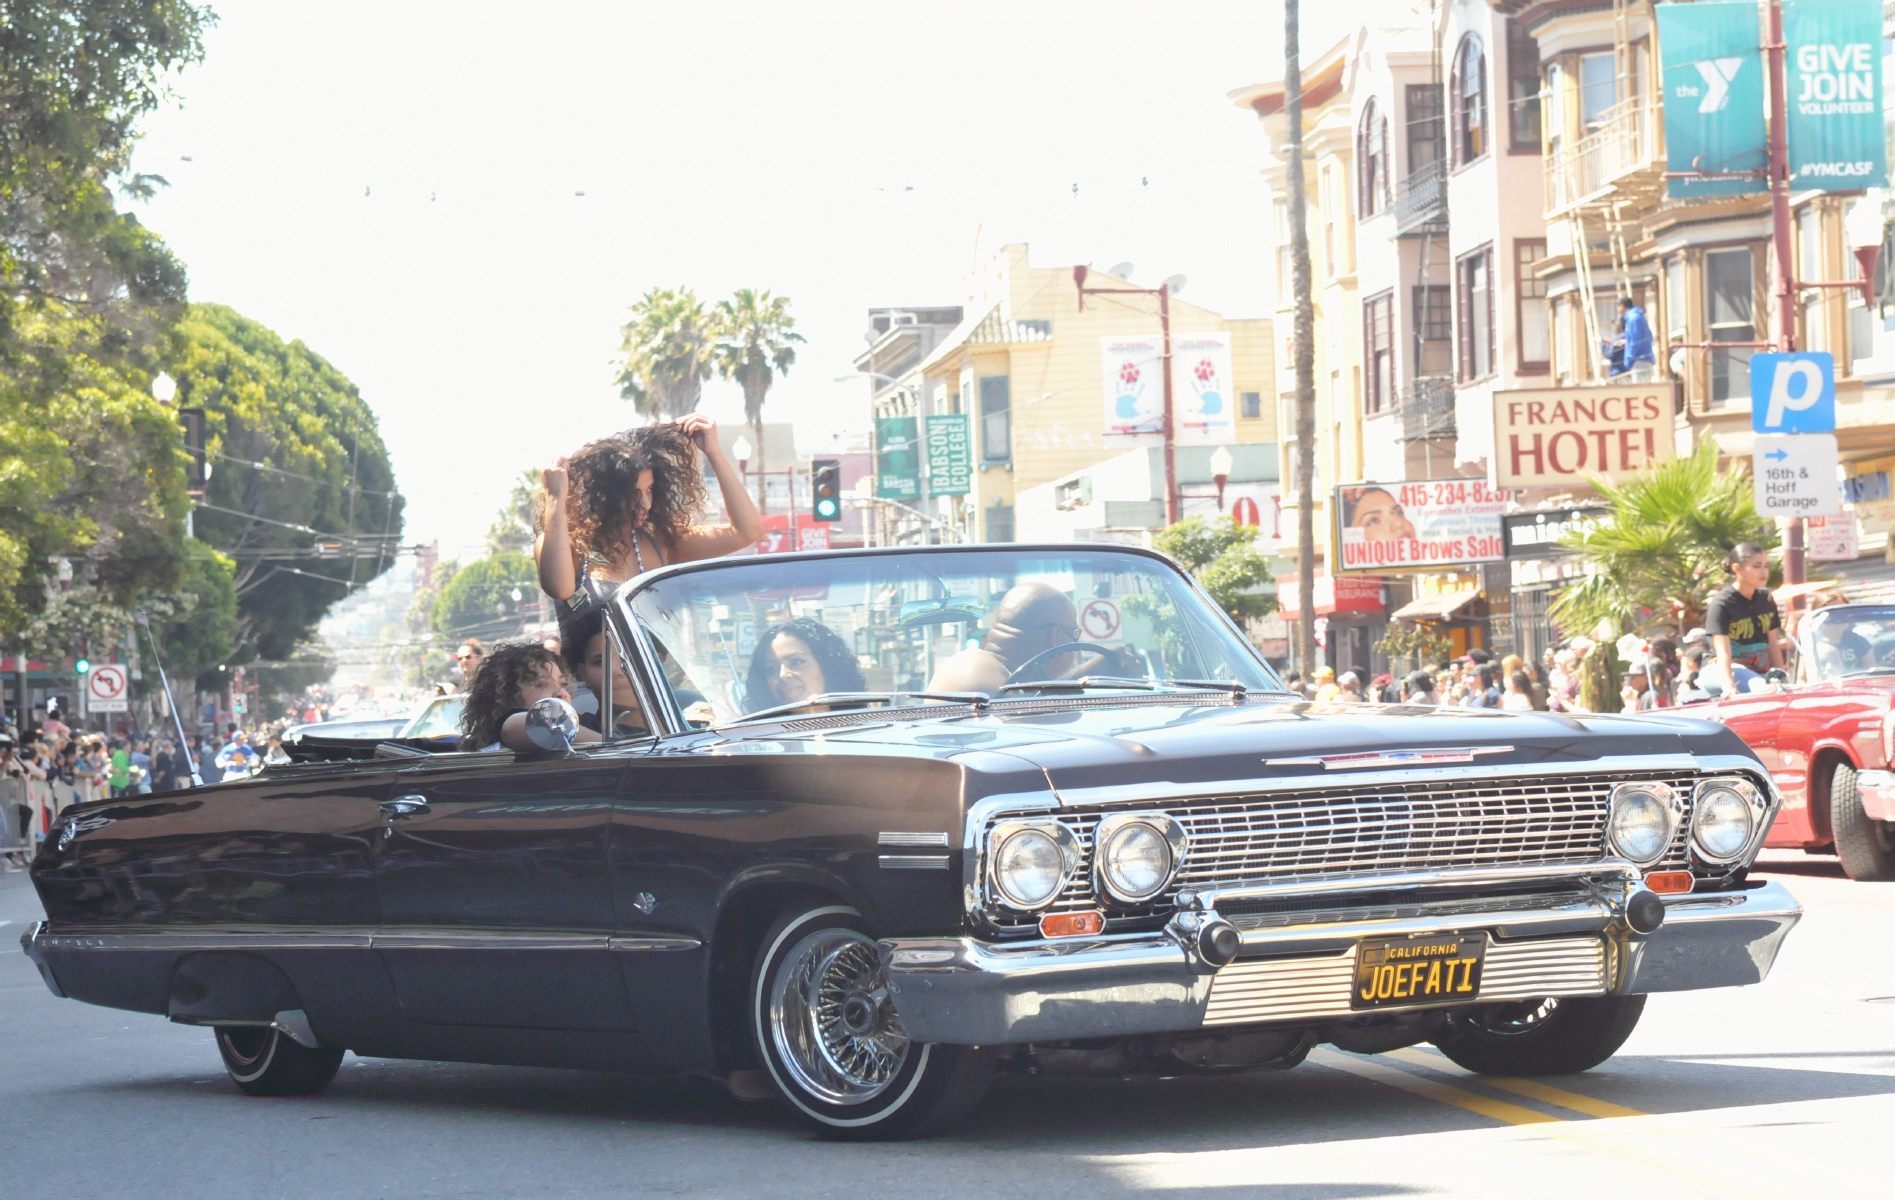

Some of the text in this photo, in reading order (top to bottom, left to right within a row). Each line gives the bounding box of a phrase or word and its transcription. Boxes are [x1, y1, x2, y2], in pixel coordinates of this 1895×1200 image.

[1796, 43, 1873, 72] GIVE
[1675, 85, 1699, 98] the
[1797, 73, 1875, 101] JOIN
[1798, 101, 1875, 115] VOLUNTEER
[1800, 161, 1874, 177] #YMCASF
[1508, 395, 1660, 427] FRANCES
[928, 424, 951, 488] BABSON
[947, 423, 969, 487] COLLEGE
[1766, 466, 1809, 480] 16th &
[1766, 482, 1798, 494] Hoff
[1766, 496, 1818, 509] Garage
[1344, 539, 1406, 566] UNIQUE
[1409, 538, 1463, 561] Brows
[1390, 943, 1458, 959] CALIFORNIA
[1361, 957, 1477, 1000] JOEFATI
